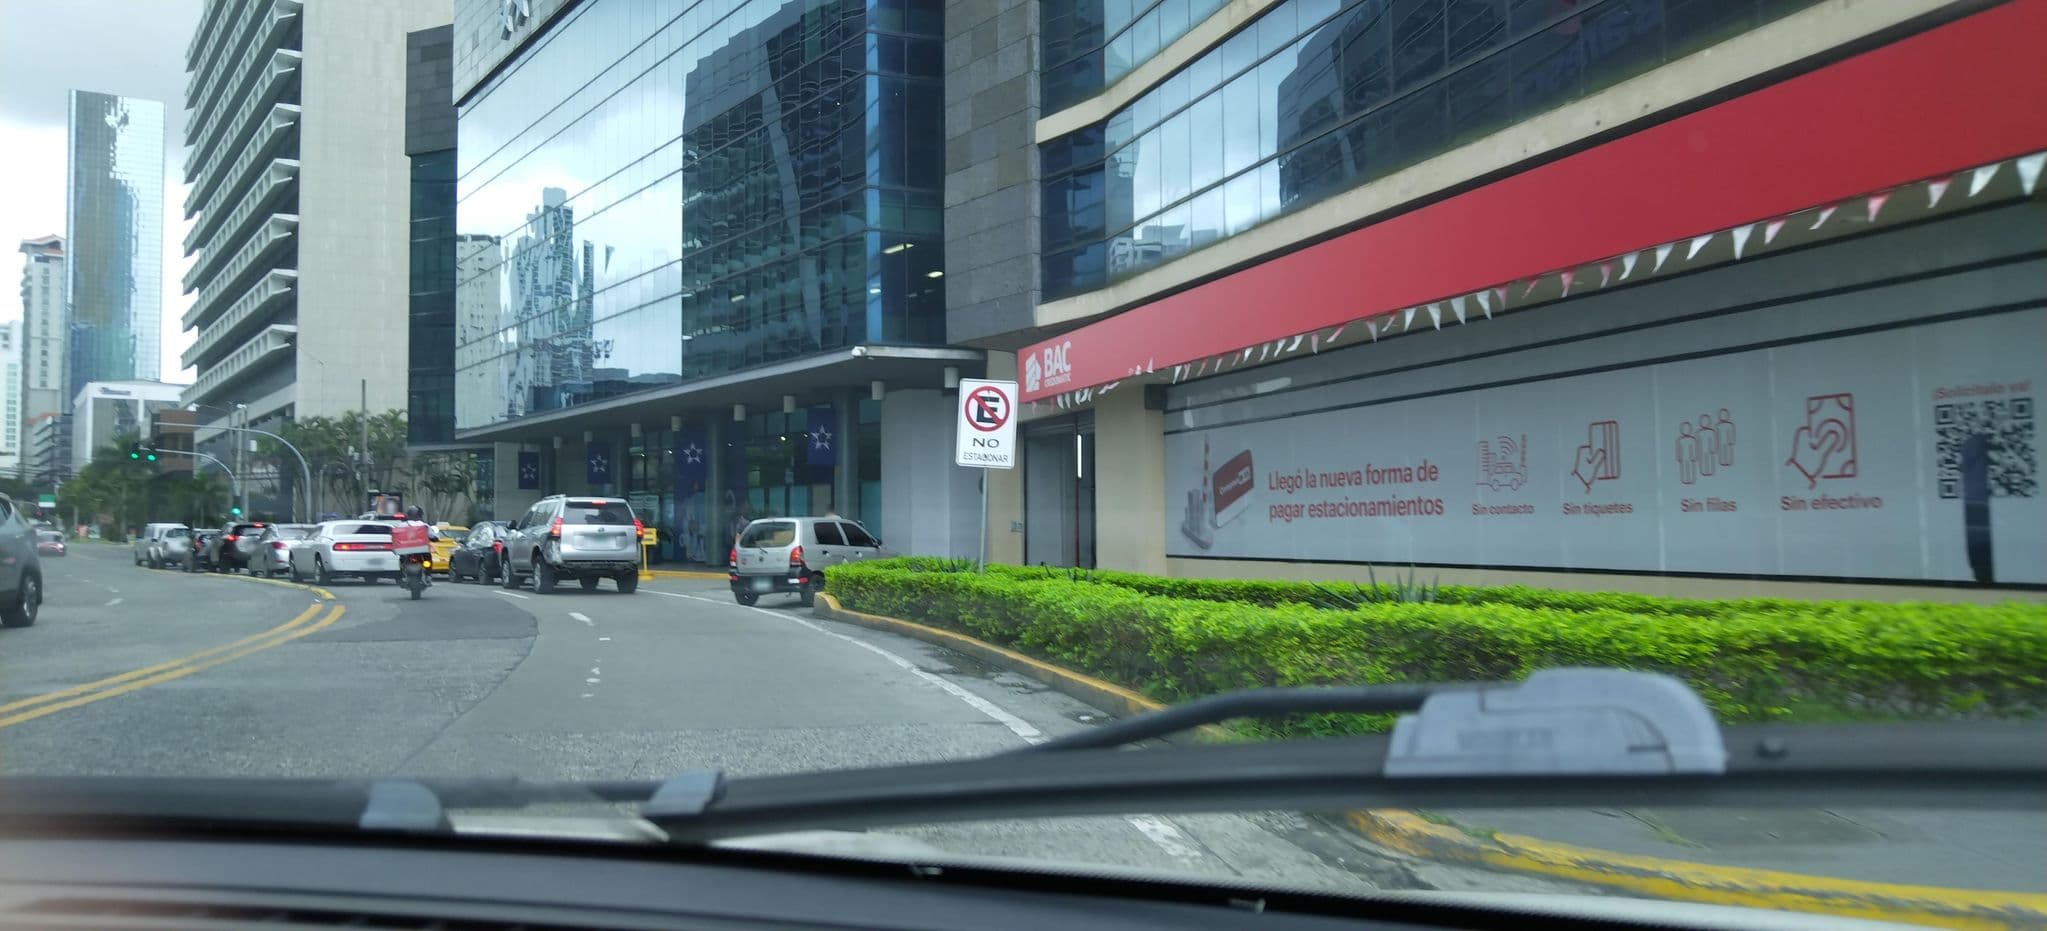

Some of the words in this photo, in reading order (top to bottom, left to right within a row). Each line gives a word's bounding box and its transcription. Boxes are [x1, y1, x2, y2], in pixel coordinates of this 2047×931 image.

[1044, 341, 1071, 377] BAC
[973, 438, 1000, 448] NO
[963, 451, 1009, 463] ESTACIONAR
[1268, 467, 1303, 494] Llegó
[1305, 468, 1317, 488] la
[1320, 470, 1362, 488] nueva
[1366, 463, 1413, 485] forma
[1416, 458, 1439, 482] de
[1269, 501, 1305, 523] pagar
[1308, 494, 1444, 518] estacionamientos
[1472, 503, 1488, 515] Sin
[1489, 503, 1535, 515] contacto
[1563, 502, 1581, 515] Sin
[1583, 502, 1633, 517] tiquetes
[1680, 498, 1703, 512] Sin
[1706, 496, 1737, 512] filas
[1781, 495, 1807, 511] Sin
[1811, 493, 1883, 510] efectivo
